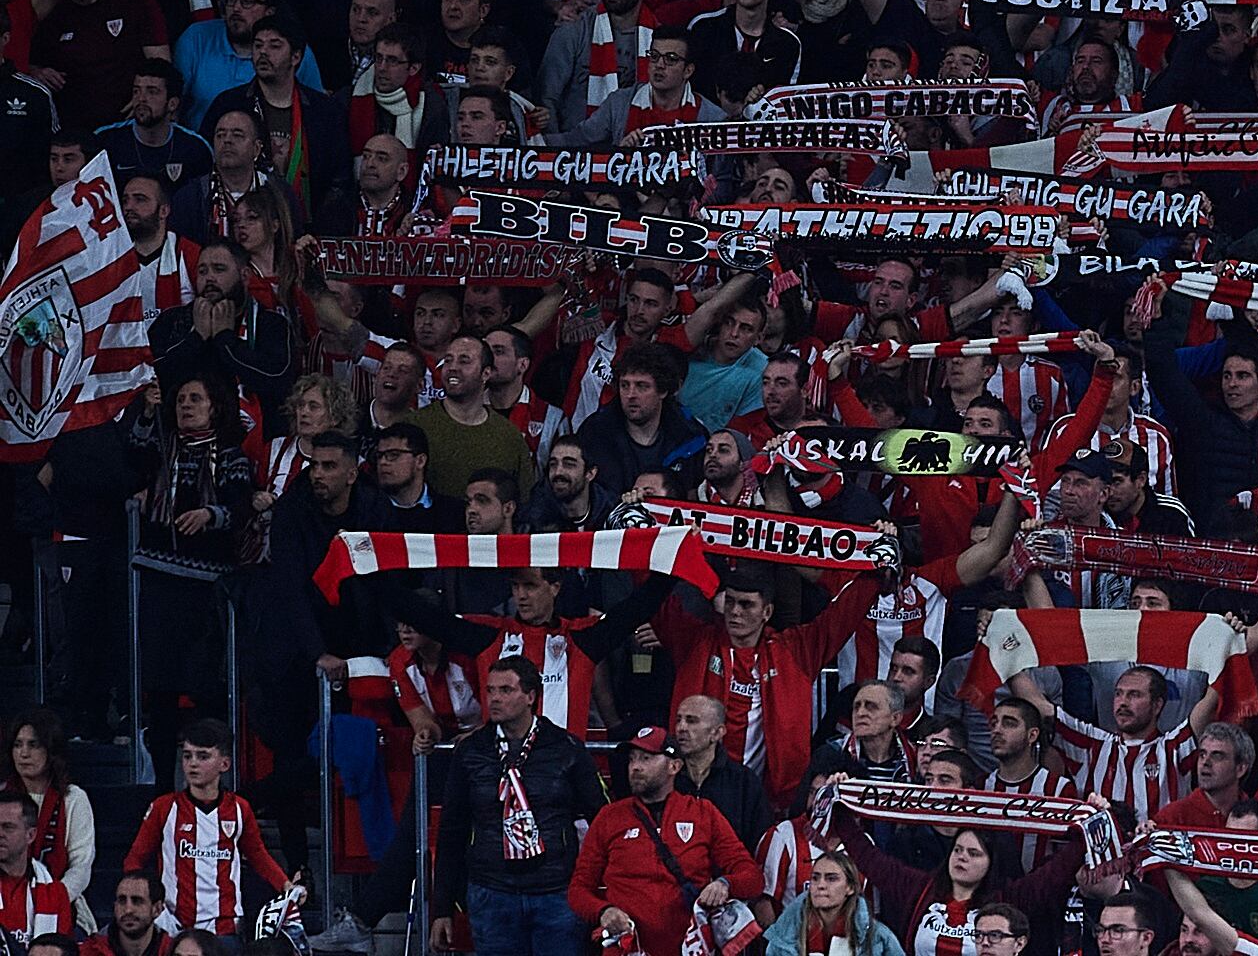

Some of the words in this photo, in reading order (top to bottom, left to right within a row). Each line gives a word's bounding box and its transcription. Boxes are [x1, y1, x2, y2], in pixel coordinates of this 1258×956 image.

[783, 92, 873, 121] INIGO
[883, 89, 1030, 118] CABACAS
[737, 122, 883, 150] CABACAS
[552, 149, 593, 186] GU
[1072, 184, 1113, 220] GU
[750, 206, 1004, 248] ATHLETIC
[1008, 215, 1060, 249] 98
[730, 515, 858, 561] BILBAO
[860, 785, 988, 817] Athletic
[1002, 796, 1087, 822] Club
[179, 839, 232, 861] Kutxabank
